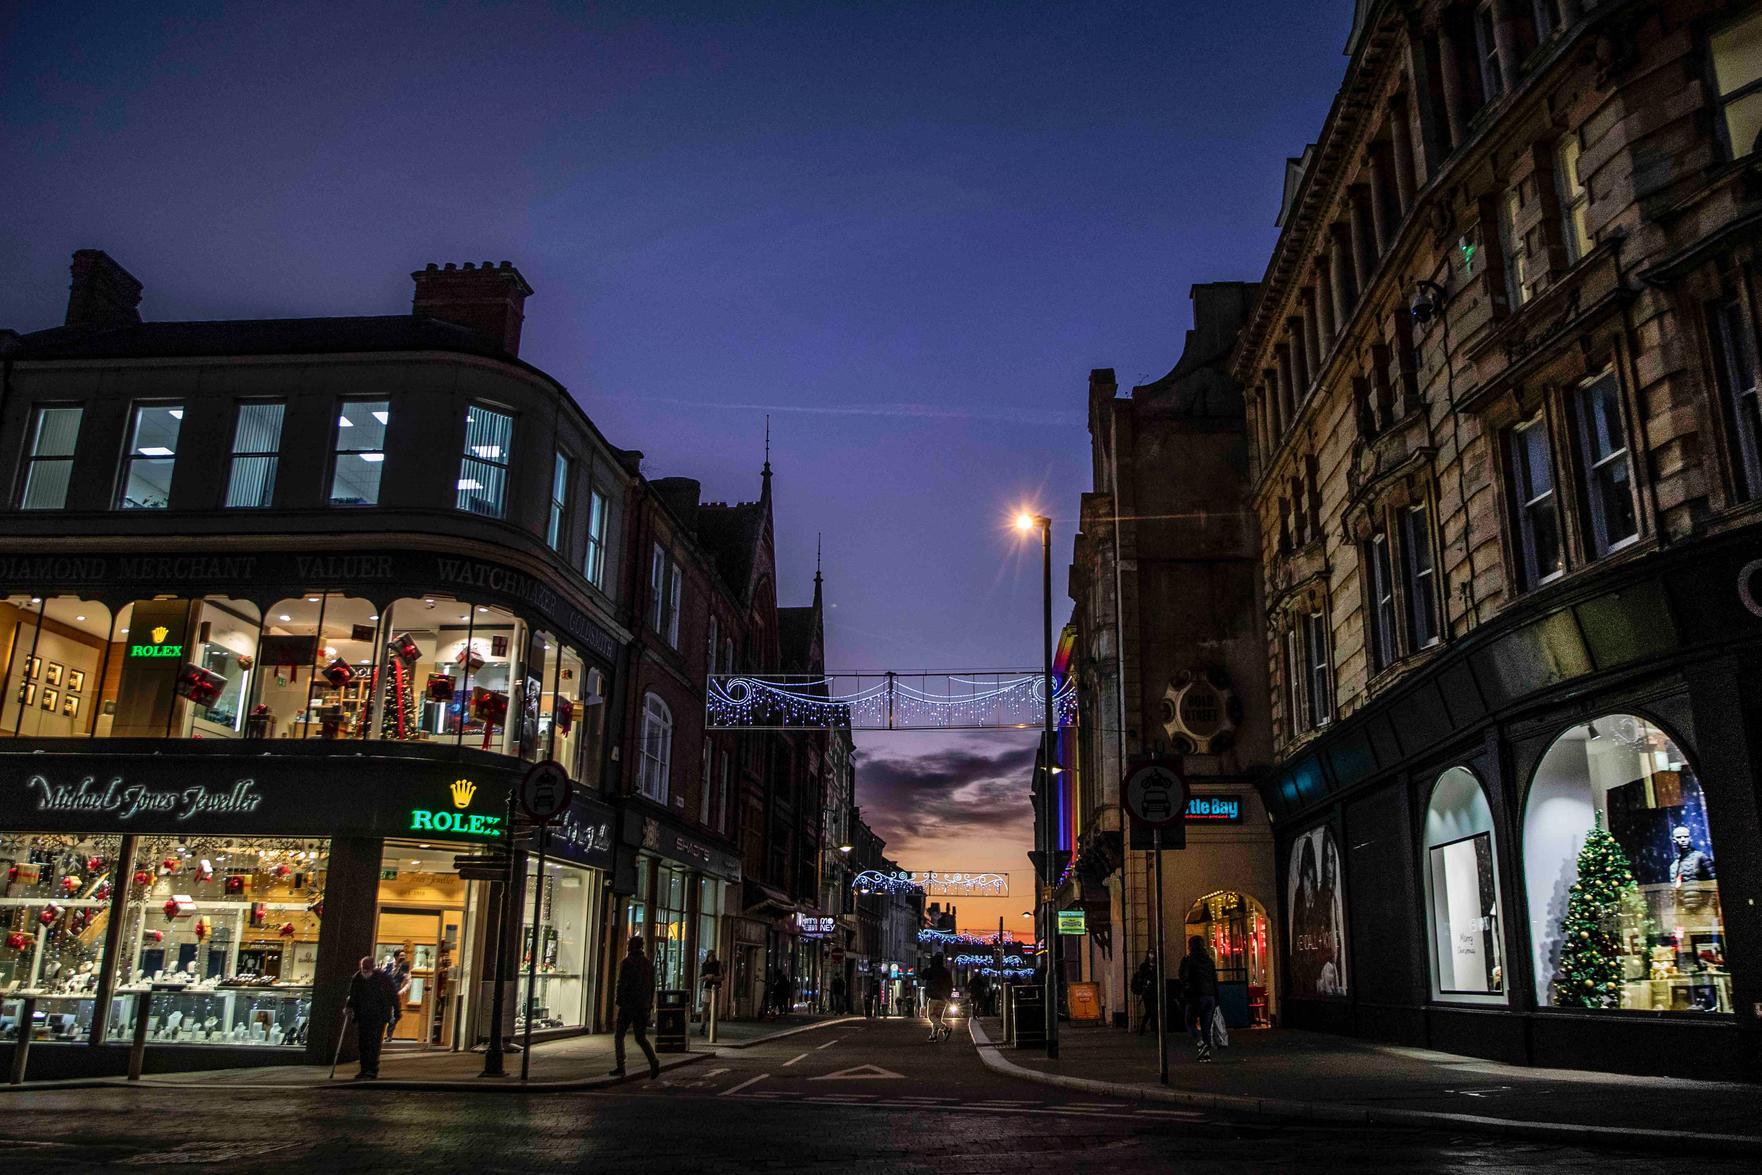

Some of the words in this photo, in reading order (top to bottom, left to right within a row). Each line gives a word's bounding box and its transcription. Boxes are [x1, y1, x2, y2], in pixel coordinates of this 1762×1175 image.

[120, 556, 258, 580] MERCHANT
[297, 555, 394, 579] VALUER
[438, 557, 558, 616] WATCHMAKER
[569, 611, 615, 658] GOLDSMITH
[130, 644, 184, 658] ROLEX
[27, 775, 123, 811] Michael
[119, 784, 180, 819] Jones
[177, 778, 262, 820] Jeweller
[1185, 798, 1210, 815] tle
[1211, 798, 1239, 819] Bay
[409, 809, 502, 838] ROLEX
